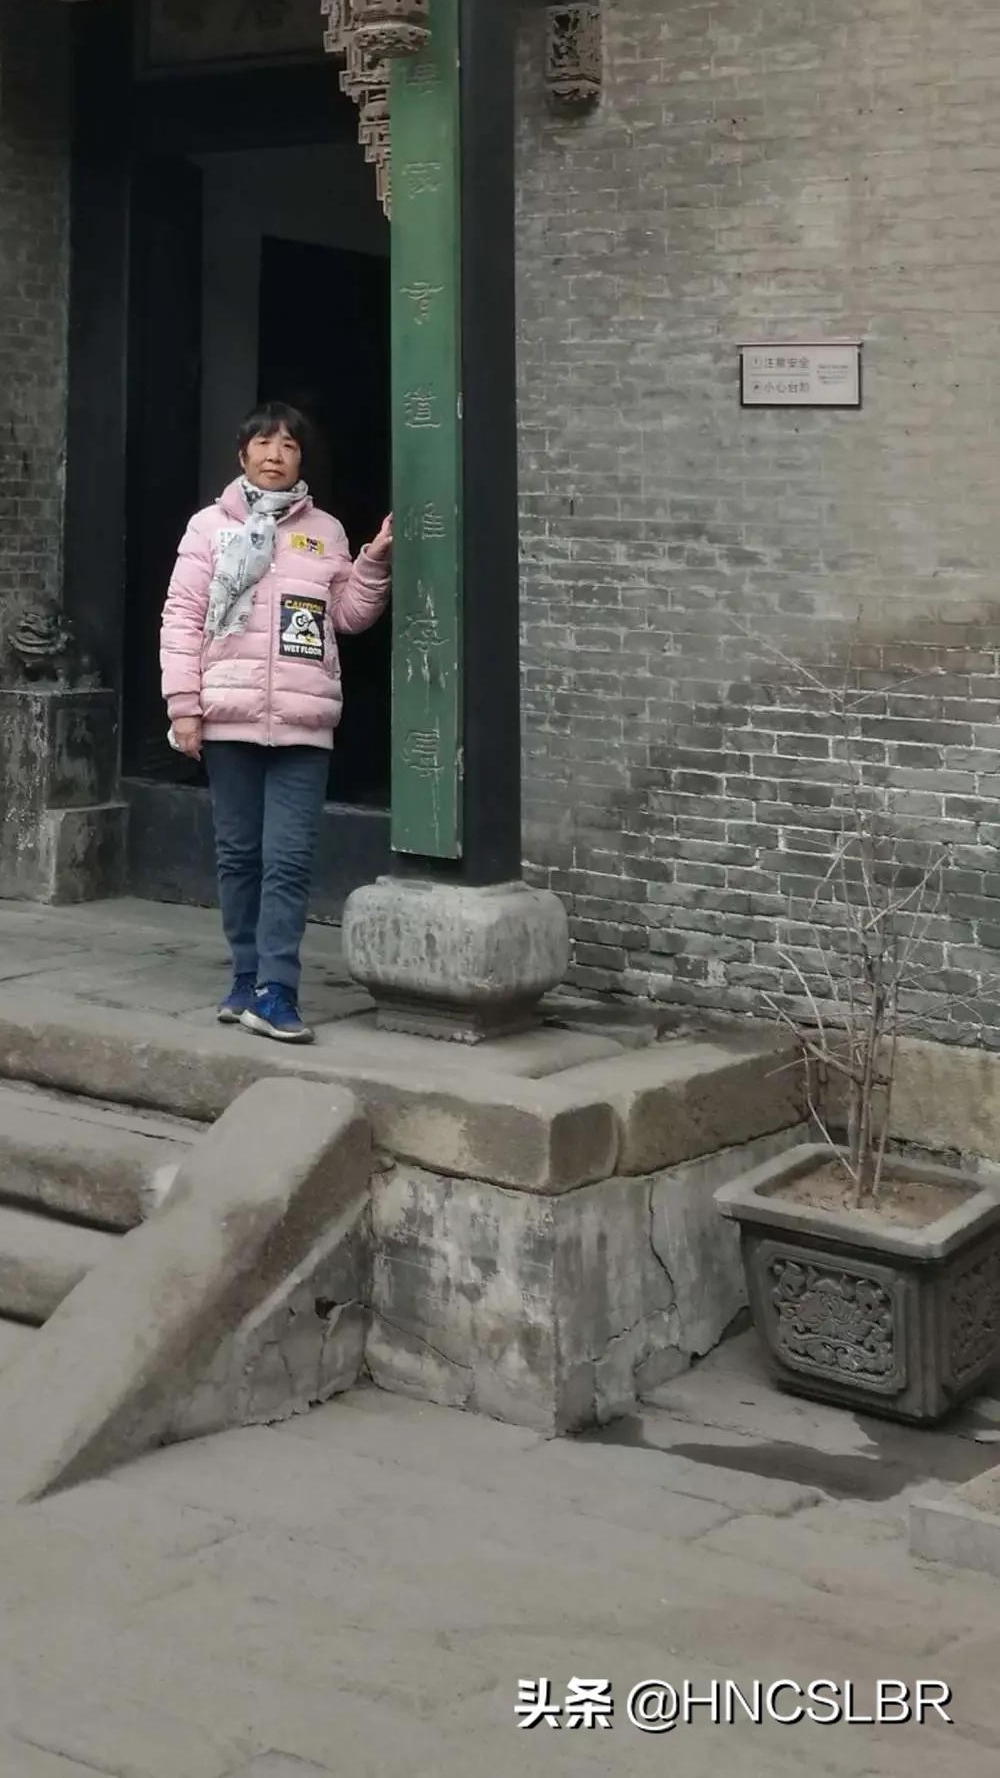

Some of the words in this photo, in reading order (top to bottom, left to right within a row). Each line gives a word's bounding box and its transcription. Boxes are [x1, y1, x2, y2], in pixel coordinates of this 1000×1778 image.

[764, 357, 809, 369] 注意安全
[283, 643, 300, 654] WET
[300, 645, 322, 657] FLOOR
